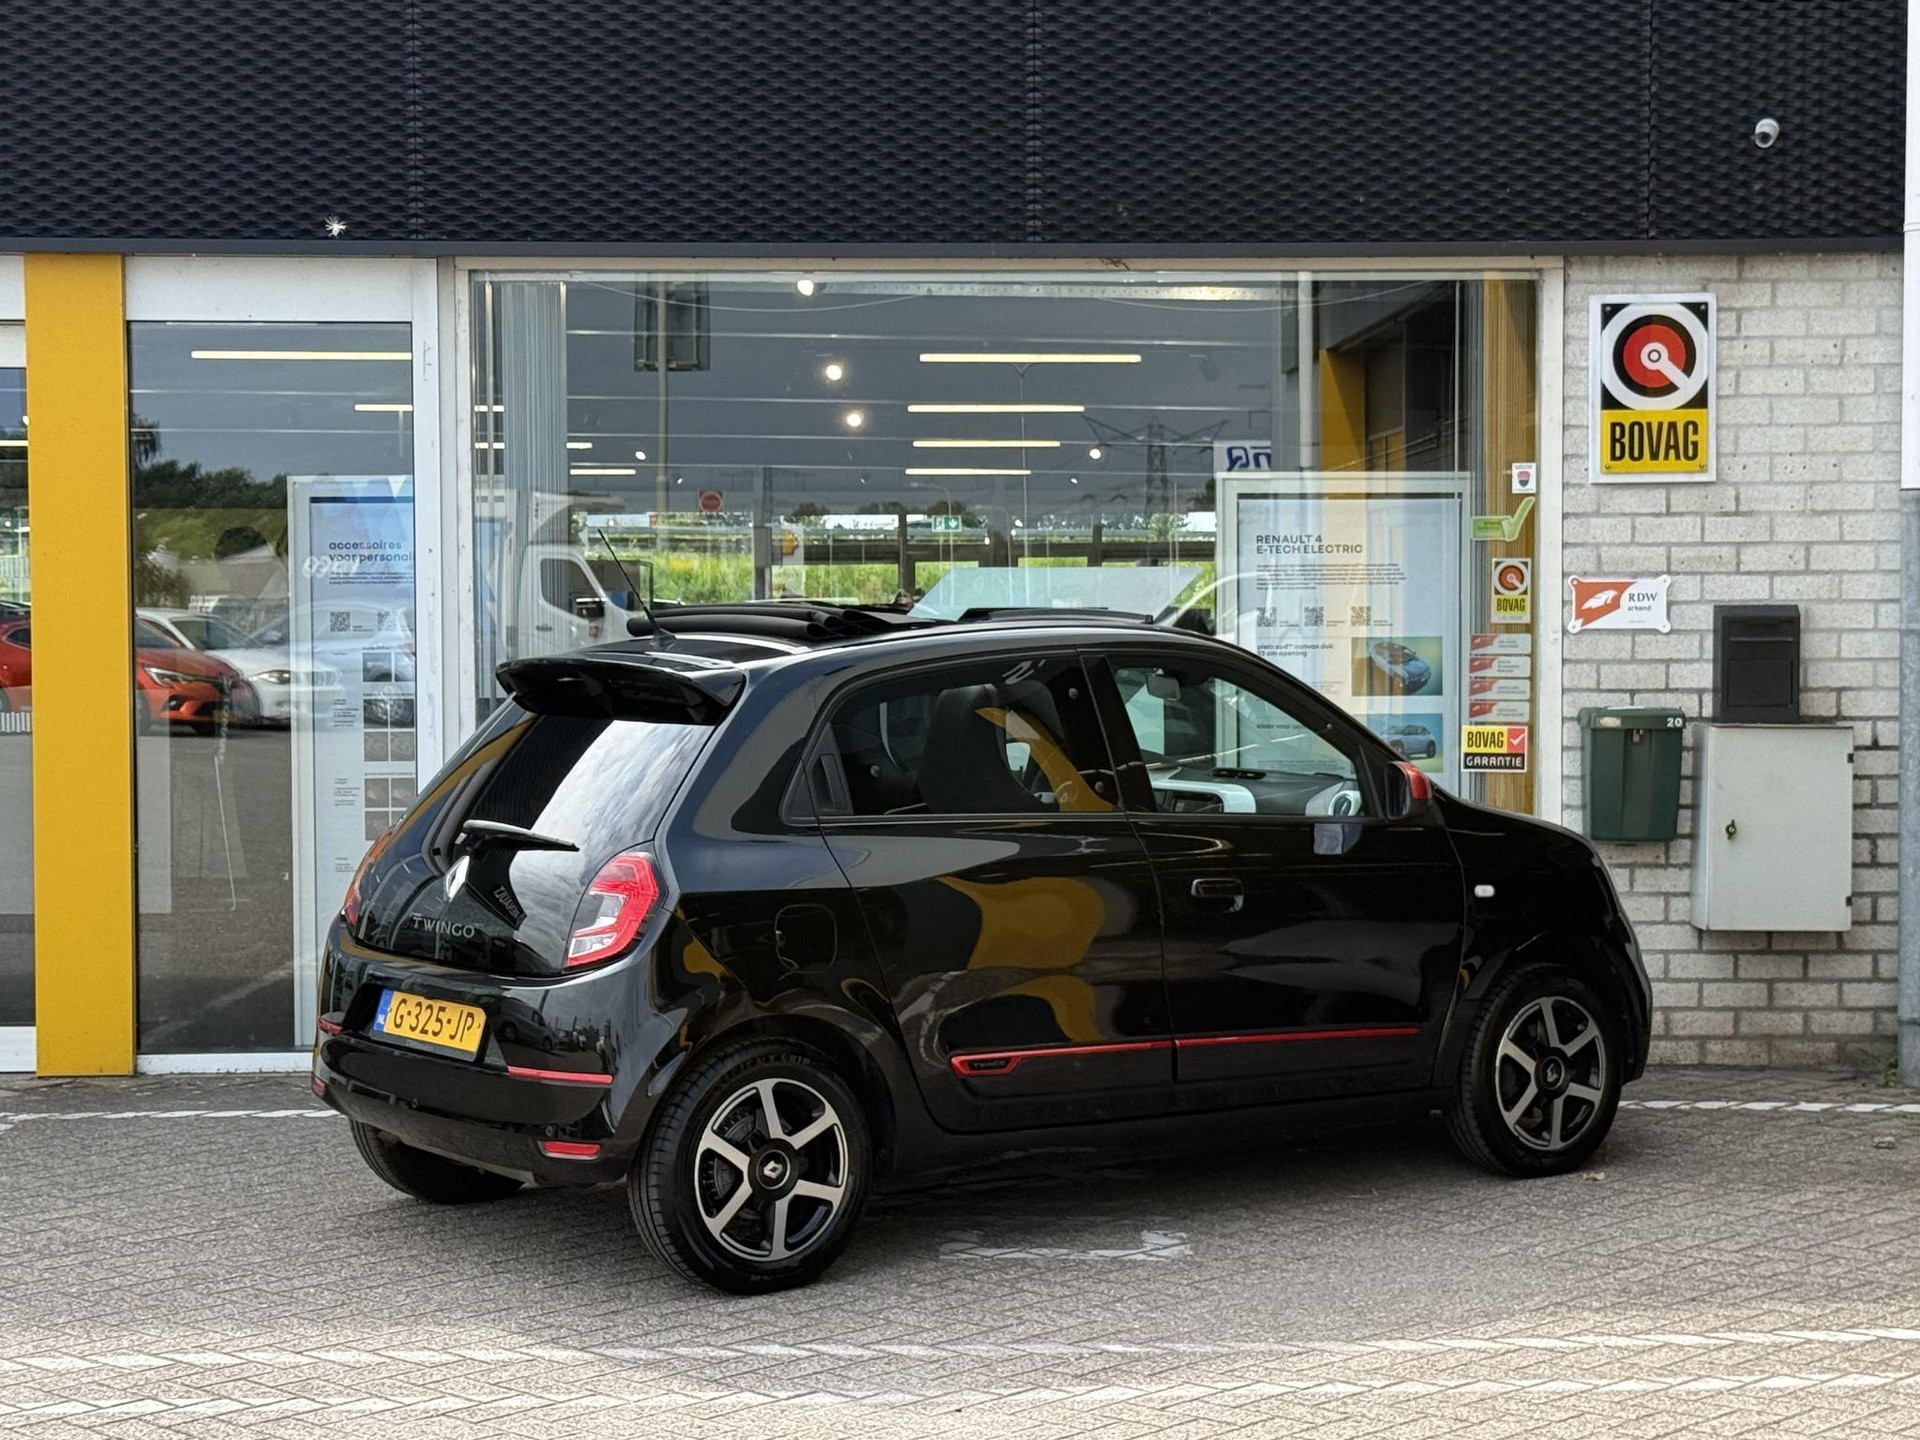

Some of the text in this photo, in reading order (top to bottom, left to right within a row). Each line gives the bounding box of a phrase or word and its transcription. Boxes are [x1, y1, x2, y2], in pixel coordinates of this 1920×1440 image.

[1609, 419, 1699, 462] BOVAG
[1256, 534, 1323, 544] RENAULT 4
[329, 540, 402, 550] accessoires
[1256, 544, 1363, 554] E-TECH ELECTRIC
[1628, 592, 1658, 602] RDW
[1496, 598, 1526, 612] BOVAG
[1666, 717, 1682, 728] 20
[1467, 731, 1504, 748] BOVAG
[1466, 756, 1522, 767] GARANTIE
[412, 915, 475, 939] TWINGO
[393, 998, 475, 1043] G-325-JP
